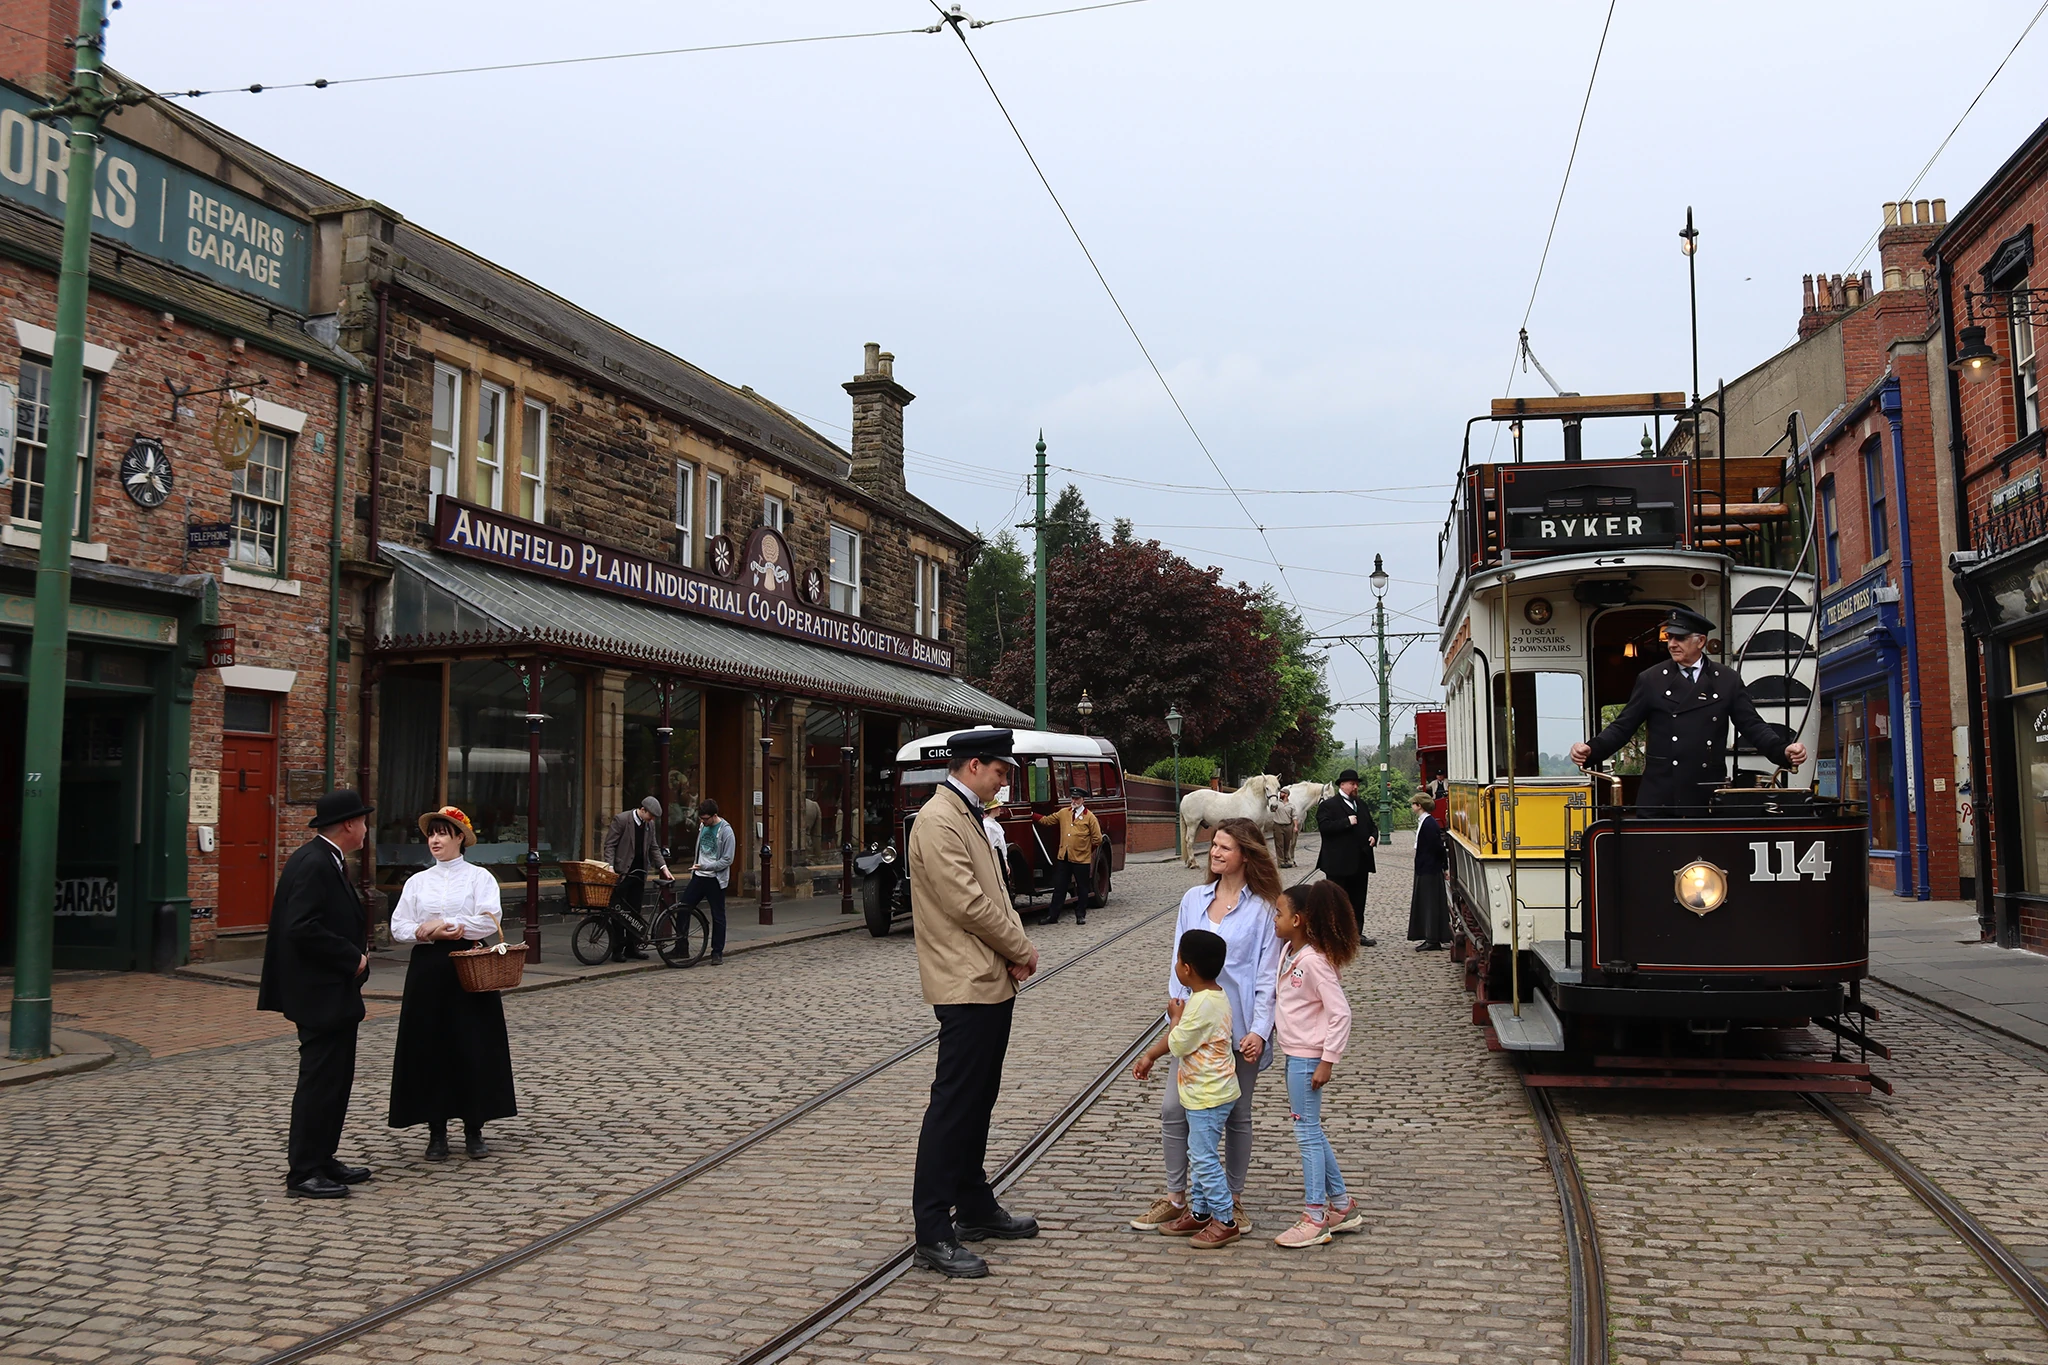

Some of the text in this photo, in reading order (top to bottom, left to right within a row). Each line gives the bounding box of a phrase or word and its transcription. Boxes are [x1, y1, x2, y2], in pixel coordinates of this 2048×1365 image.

[188, 189, 284, 257] REPAIRS
[187, 225, 281, 289] GARAGE
[189, 530, 229, 542] TELEPHONE
[449, 507, 574, 571] ANNFIELD
[580, 542, 642, 589] PLAIN
[645, 562, 745, 616] INDUSTRIAL
[749, 591, 849, 642] CO-OPERATIVE
[851, 621, 900, 653] SOCIETY
[912, 637, 951, 668] BEAMISH
[1827, 588, 1870, 625] THE EAGLE PRESS
[211, 653, 233, 665] Oils
[928, 748, 951, 758] CIRC
[27, 772, 42, 782] 77
[1749, 840, 1832, 882] 114
